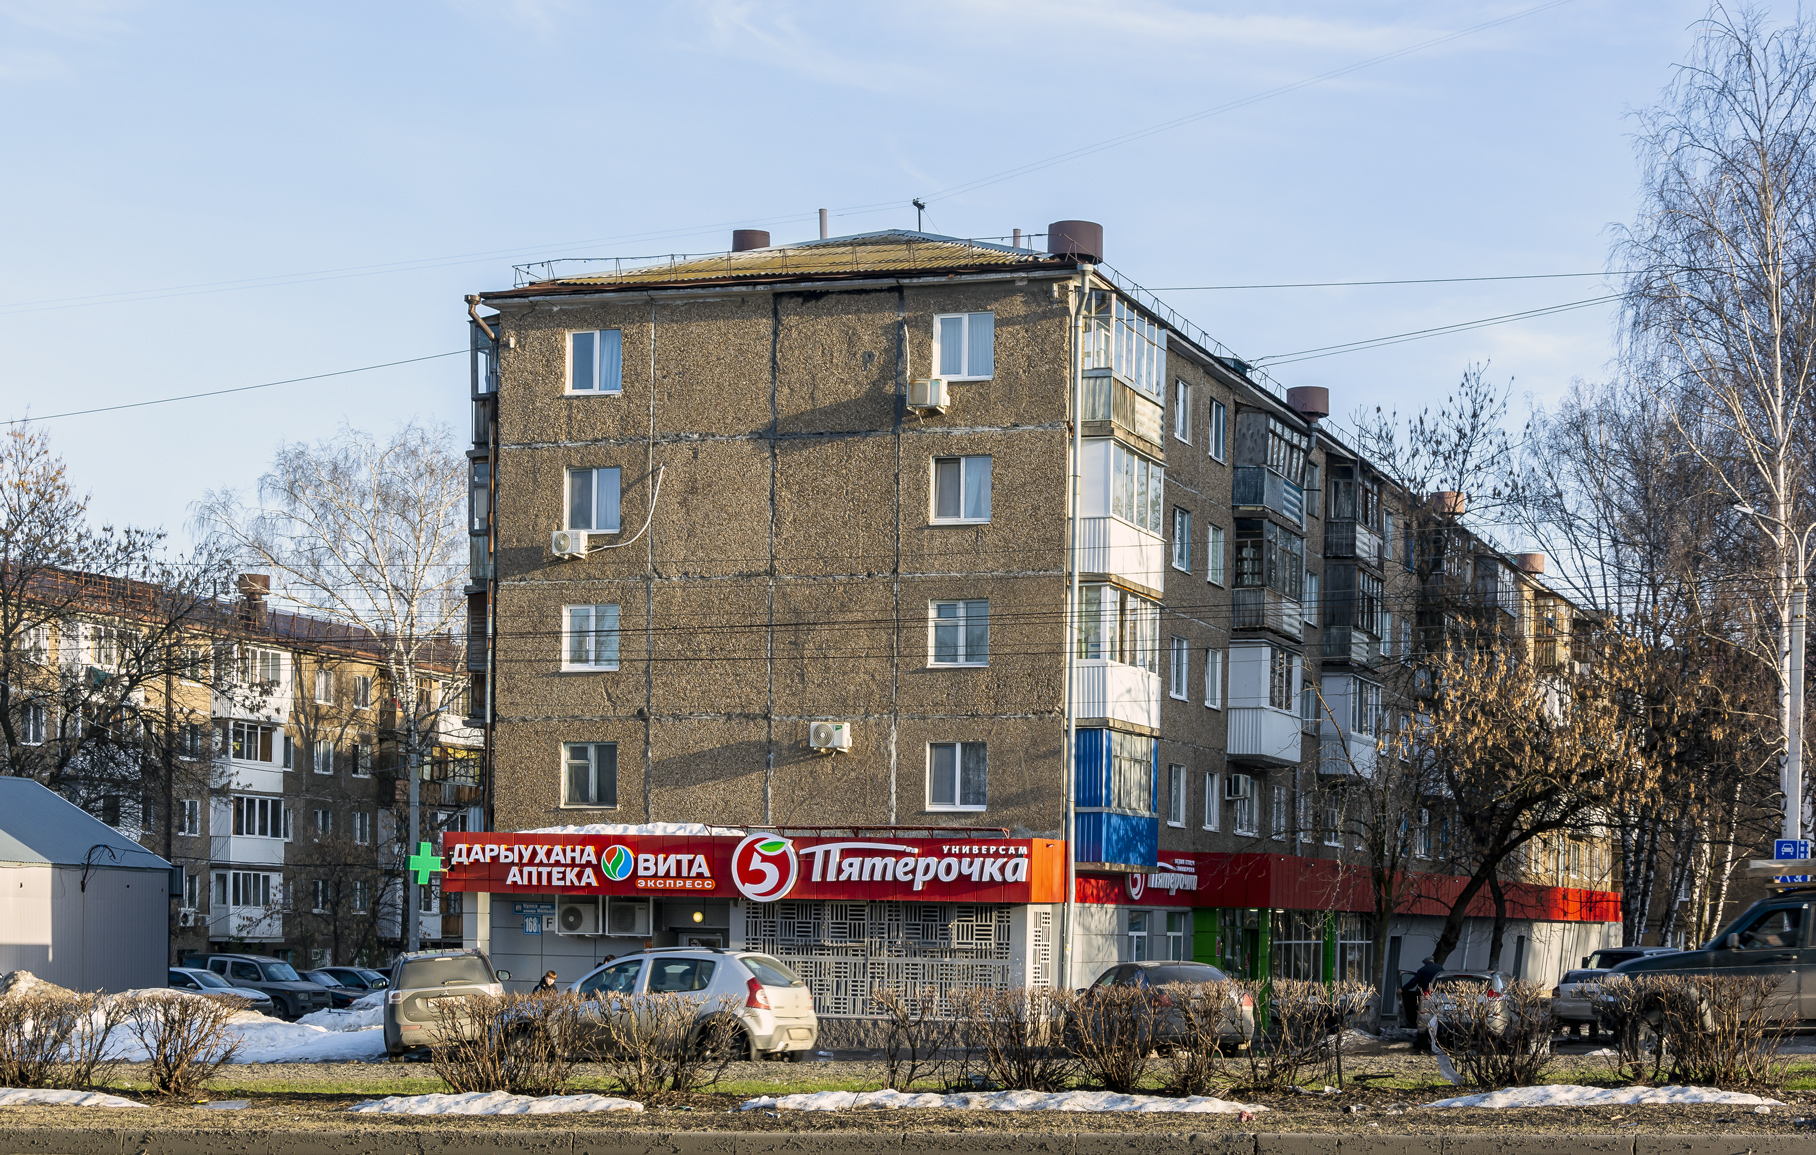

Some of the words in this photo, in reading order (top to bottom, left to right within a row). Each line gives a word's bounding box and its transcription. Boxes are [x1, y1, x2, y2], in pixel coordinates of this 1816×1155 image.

[451, 843, 598, 865] ДАРЫУХАНА
[942, 845, 1028, 854] УНИВЕРСАМ
[637, 853, 712, 877] ВИТА
[799, 842, 1029, 891] Пятерочка
[506, 866, 600, 886] АПТЕКА
[637, 879, 713, 888] ЭКСПРЕСС
[546, 917, 553, 929] F
